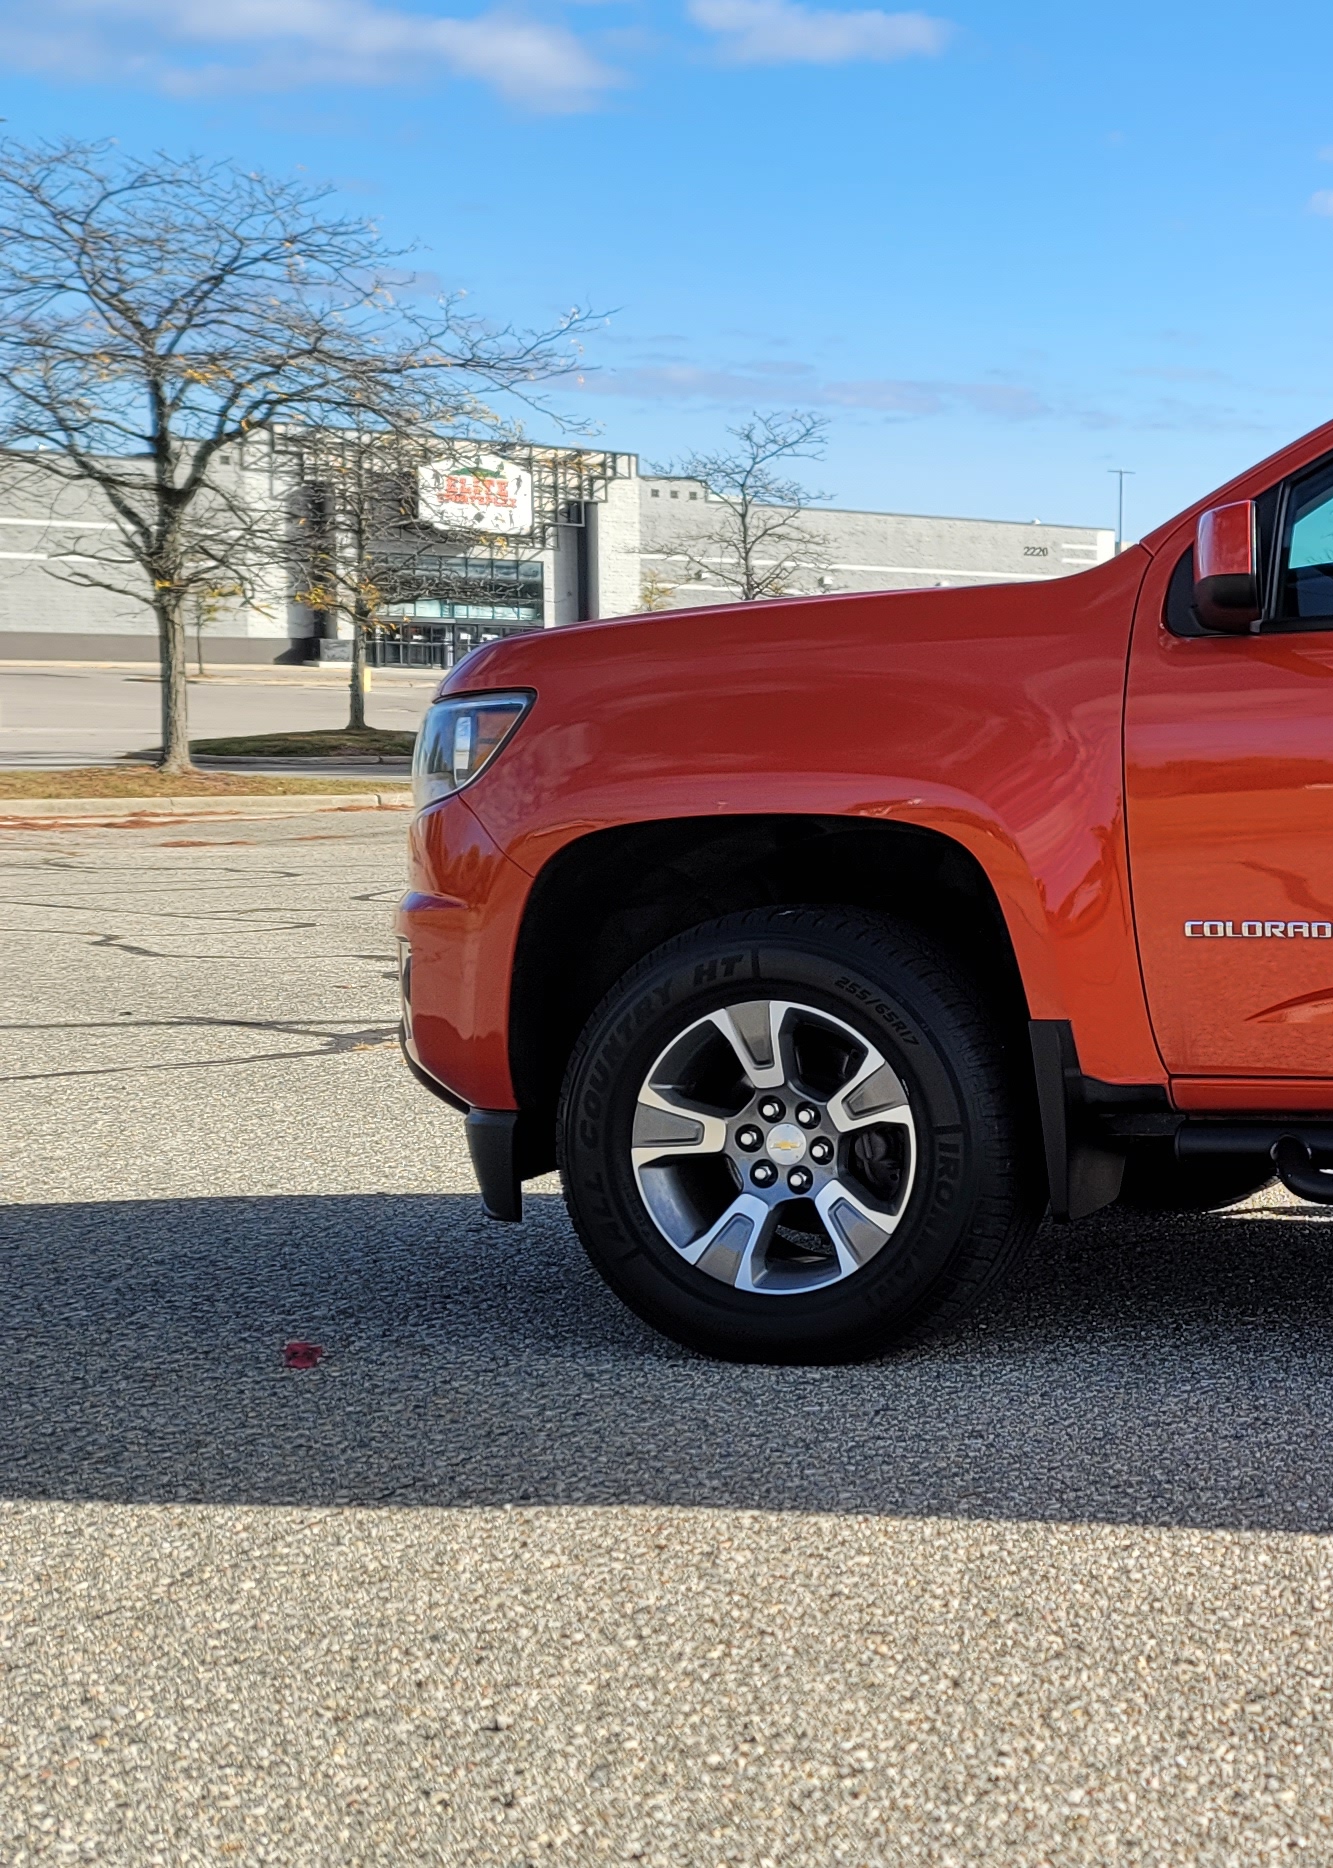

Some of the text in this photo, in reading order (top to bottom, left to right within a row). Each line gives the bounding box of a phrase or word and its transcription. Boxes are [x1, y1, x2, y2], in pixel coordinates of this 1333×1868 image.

[1023, 546, 1049, 557] 2220
[579, 977, 674, 1149] COUNTRY
[692, 953, 744, 987] HT
